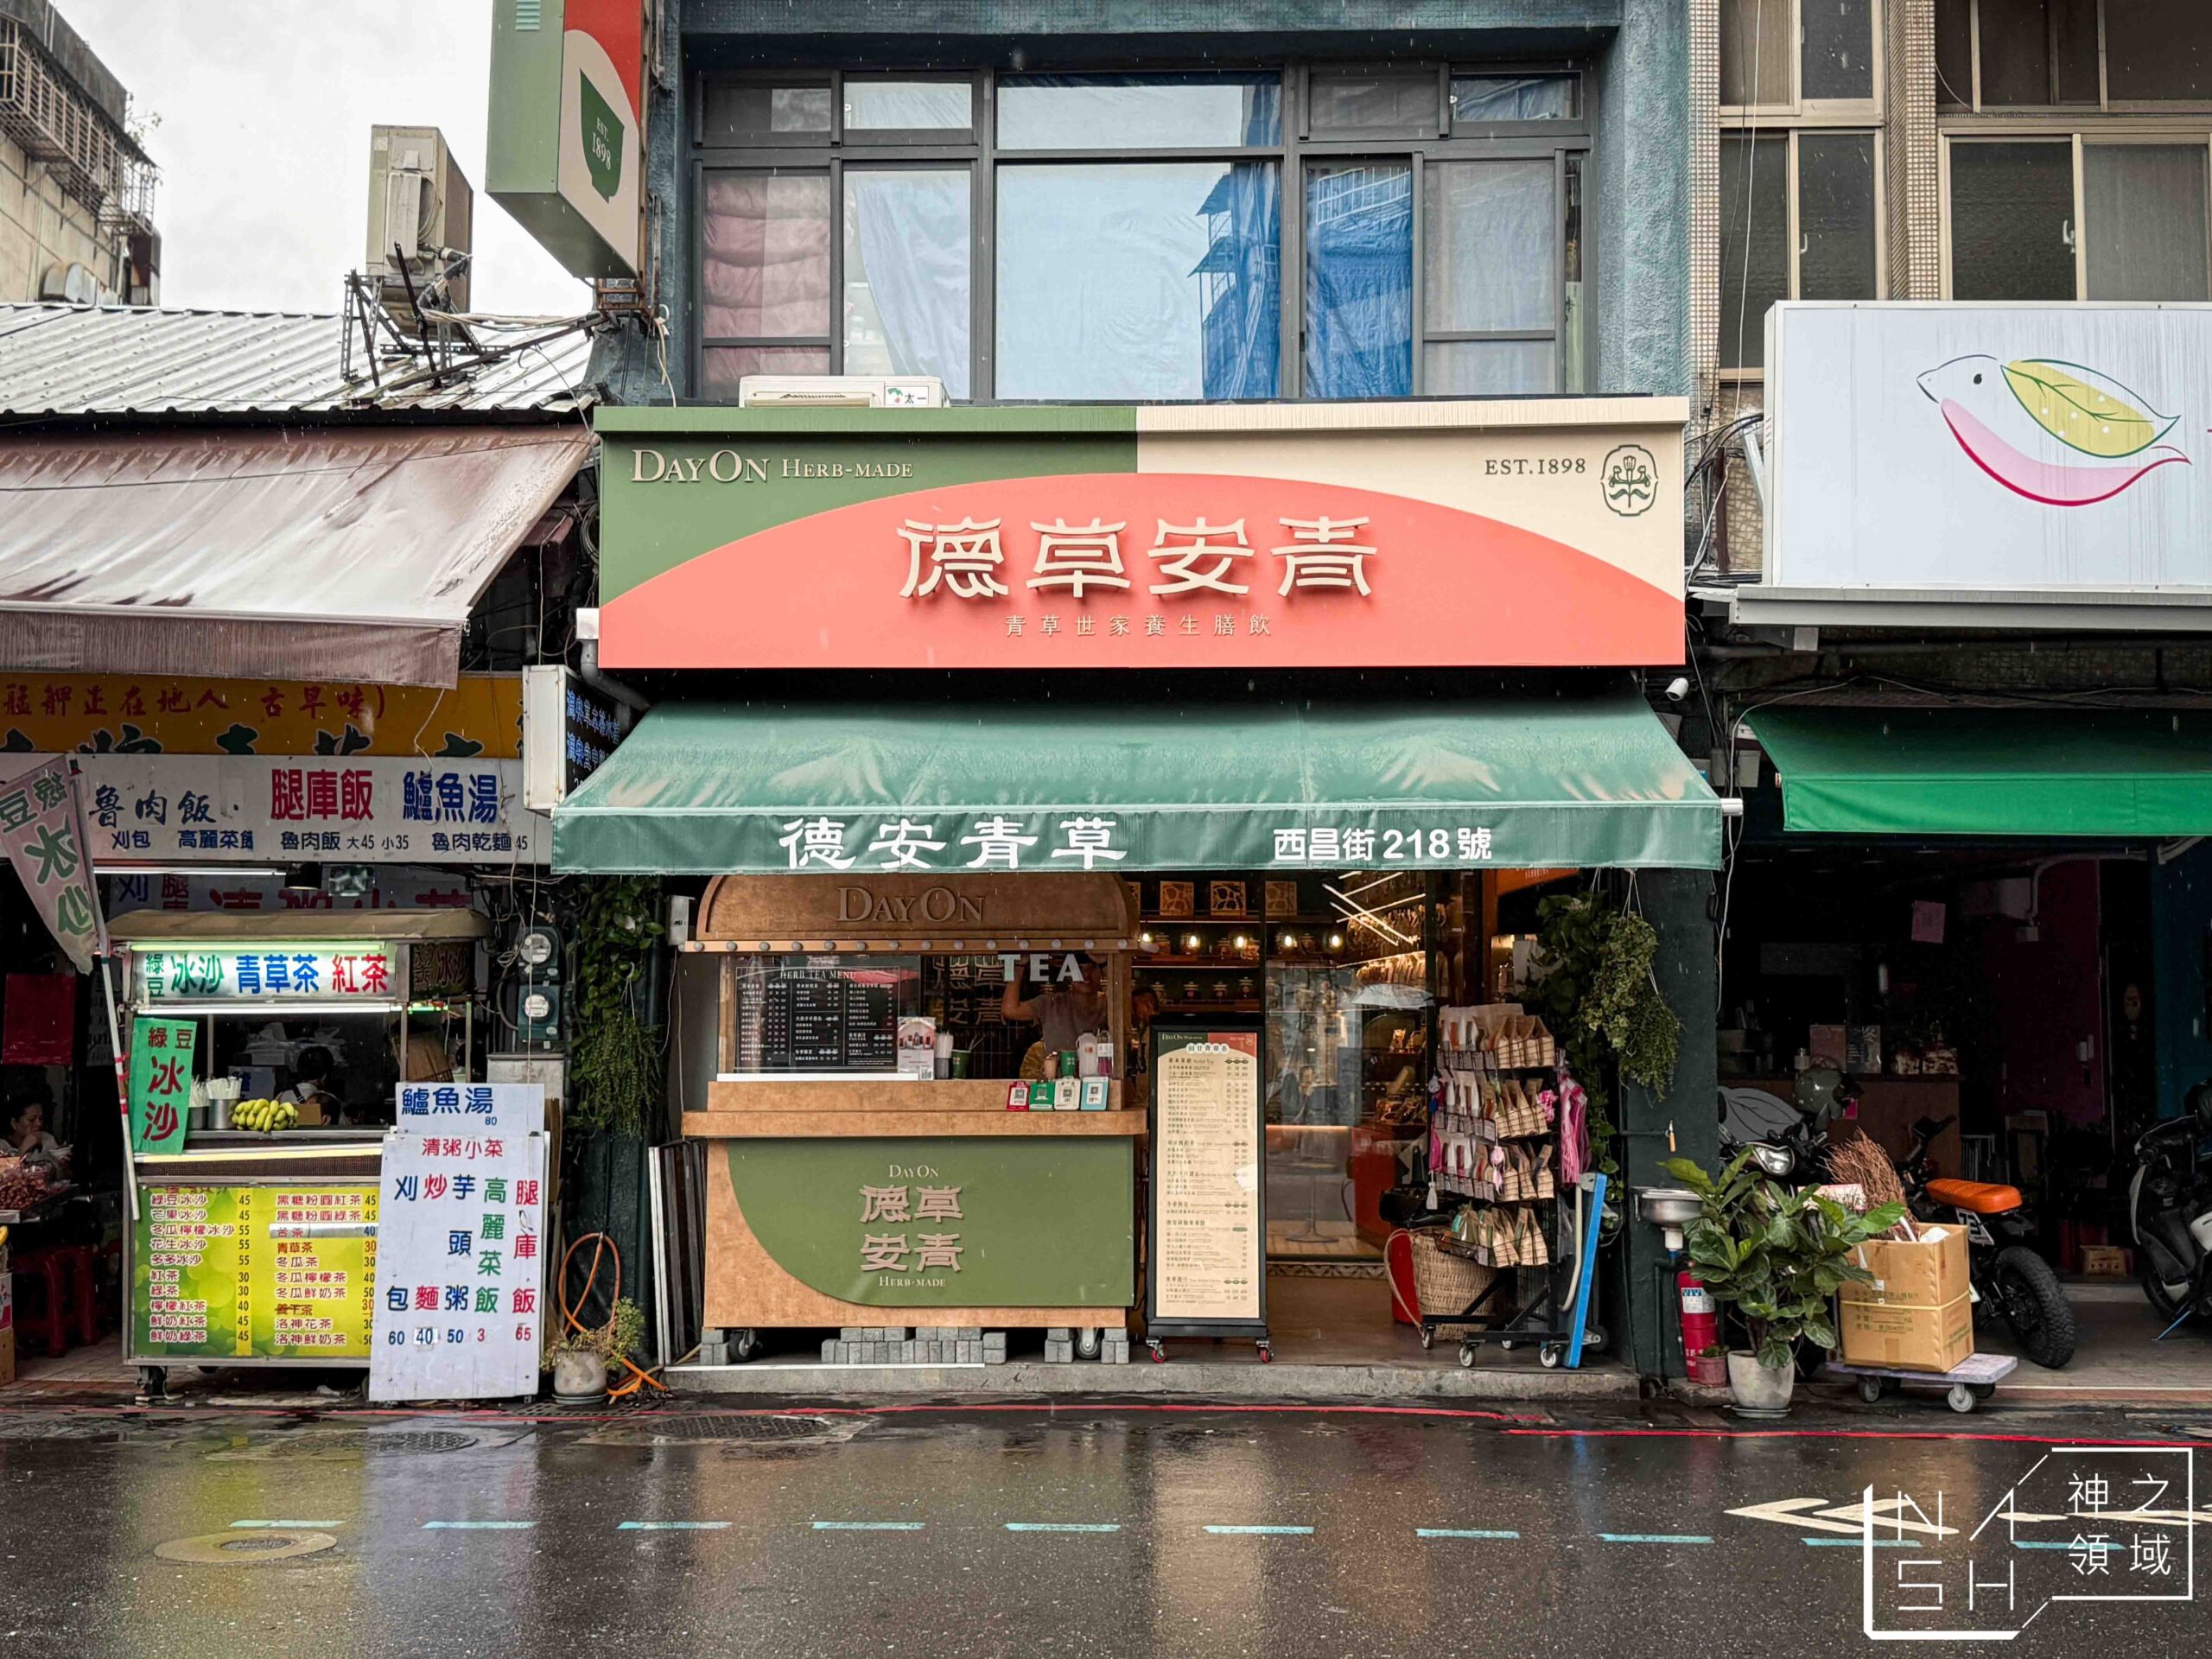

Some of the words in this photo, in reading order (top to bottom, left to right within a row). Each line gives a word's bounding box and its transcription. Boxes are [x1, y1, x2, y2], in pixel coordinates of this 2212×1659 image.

[596, 118, 609, 143] EST.
[592, 132, 611, 170] 1898
[1005, 614, 1271, 638] 青草世家養生膳飲
[270, 768, 374, 821] 腿庫飯
[403, 771, 499, 823] 鱸魚湯
[112, 830, 151, 850] 刈包
[281, 831, 340, 851] 魯肉飯
[432, 832, 512, 852] 魯肉乾麵
[779, 816, 1128, 869] 德安青草
[1274, 827, 1492, 861] 西昌街218號
[172, 954, 225, 994] 冰沙
[236, 954, 320, 995] 青草茶
[332, 954, 389, 994] 紅茶
[780, 970, 805, 979] HERB
[810, 970, 827, 979] TEA
[830, 970, 856, 979] MENU
[998, 954, 1084, 982] TEA
[145, 953, 165, 998] 綠豆
[148, 1027, 194, 1050] 綠豆
[143, 1056, 185, 1141] 冰沙
[401, 1087, 493, 1116] 鱸魚湯
[485, 1116, 498, 1126] 80
[422, 1137, 504, 1160] 清粥小菜
[151, 1194, 207, 1205] 綠豆冰沙
[238, 1195, 251, 1205] 45
[276, 1195, 362, 1205] 黑糖粉圓紅茶
[365, 1195, 377, 1205] 45
[151, 1210, 207, 1220] 芒果冰沙
[238, 1211, 251, 1221] 45
[365, 1211, 376, 1221] 45
[238, 1225, 251, 1236] 55
[364, 1226, 376, 1236] 40
[151, 1239, 207, 1249] 花生冰沙
[238, 1239, 251, 1249] 55
[277, 1243, 313, 1254] 青草茶
[365, 1241, 377, 1253] 30
[151, 1255, 202, 1265] 多多冰沙
[238, 1255, 251, 1265] 55
[276, 1257, 318, 1267] 冬瓜茶
[364, 1256, 376, 1267] 30
[150, 1270, 179, 1281] 紅茶
[238, 1272, 249, 1282] 30
[276, 1272, 346, 1283] 冬瓜檸檬茶
[364, 1273, 375, 1283] 40
[150, 1285, 179, 1296] 綠茶
[238, 1286, 249, 1296] 30
[276, 1287, 346, 1298] 冬瓜鮮奶茶
[364, 1287, 375, 1298] 50
[238, 1300, 249, 1311] 40
[362, 1299, 374, 1311] 30
[150, 1316, 207, 1326] 鮮奶紅茶
[238, 1315, 249, 1325] 45
[276, 1319, 332, 1330] 洛神花茶
[150, 1331, 207, 1342] 鮮奶綠茶
[238, 1331, 249, 1341] 45
[276, 1334, 346, 1344] 洛神鮮奶茶
[389, 1331, 405, 1345] 60
[416, 1328, 433, 1345] 40
[447, 1329, 464, 1344] 50
[515, 1326, 531, 1341] 65
